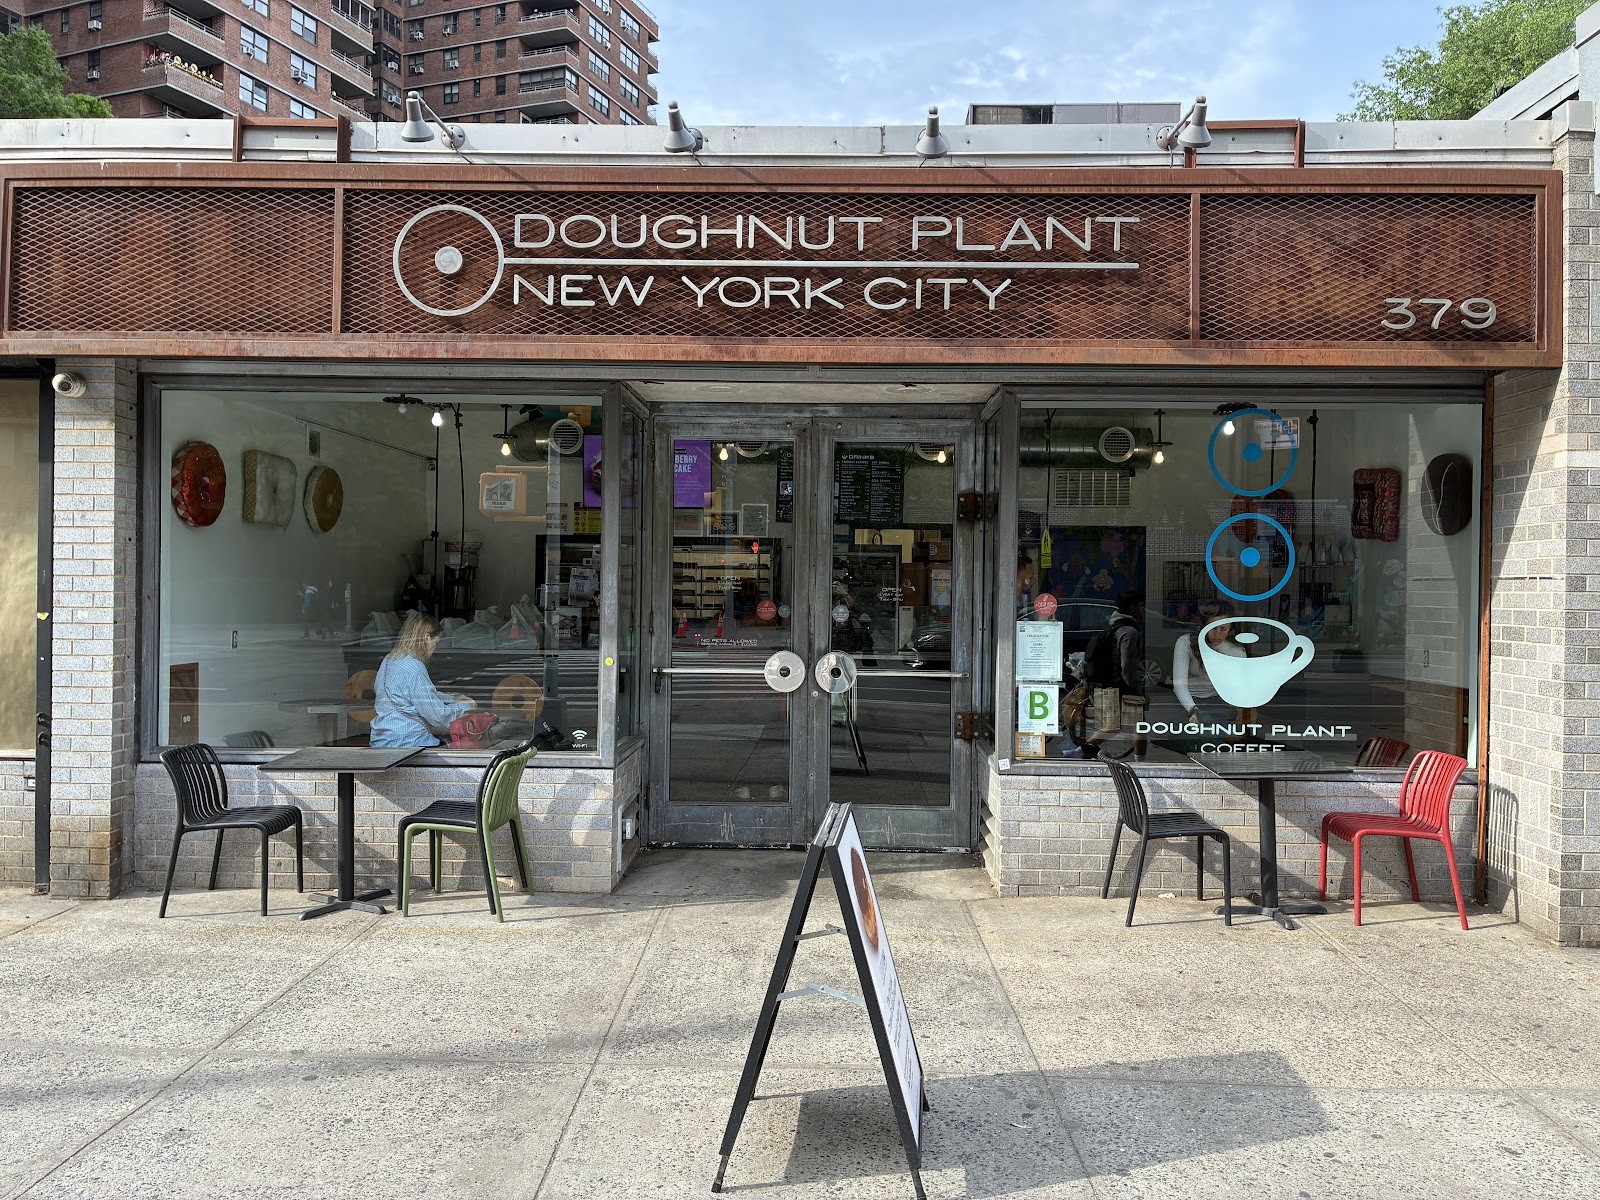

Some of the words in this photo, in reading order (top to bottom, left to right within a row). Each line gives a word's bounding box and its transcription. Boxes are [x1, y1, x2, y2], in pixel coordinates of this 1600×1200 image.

[514, 213, 883, 251] DOUGHNUT
[911, 216, 1141, 252] PLANT
[513, 274, 655, 307] NEW
[681, 275, 845, 309] YORK
[863, 277, 1012, 310] CITY
[1381, 298, 1497, 330] 379
[1029, 690, 1049, 719] B
[1135, 722, 1263, 736] DOUGHNUT
[1271, 725, 1352, 738] PLANT
